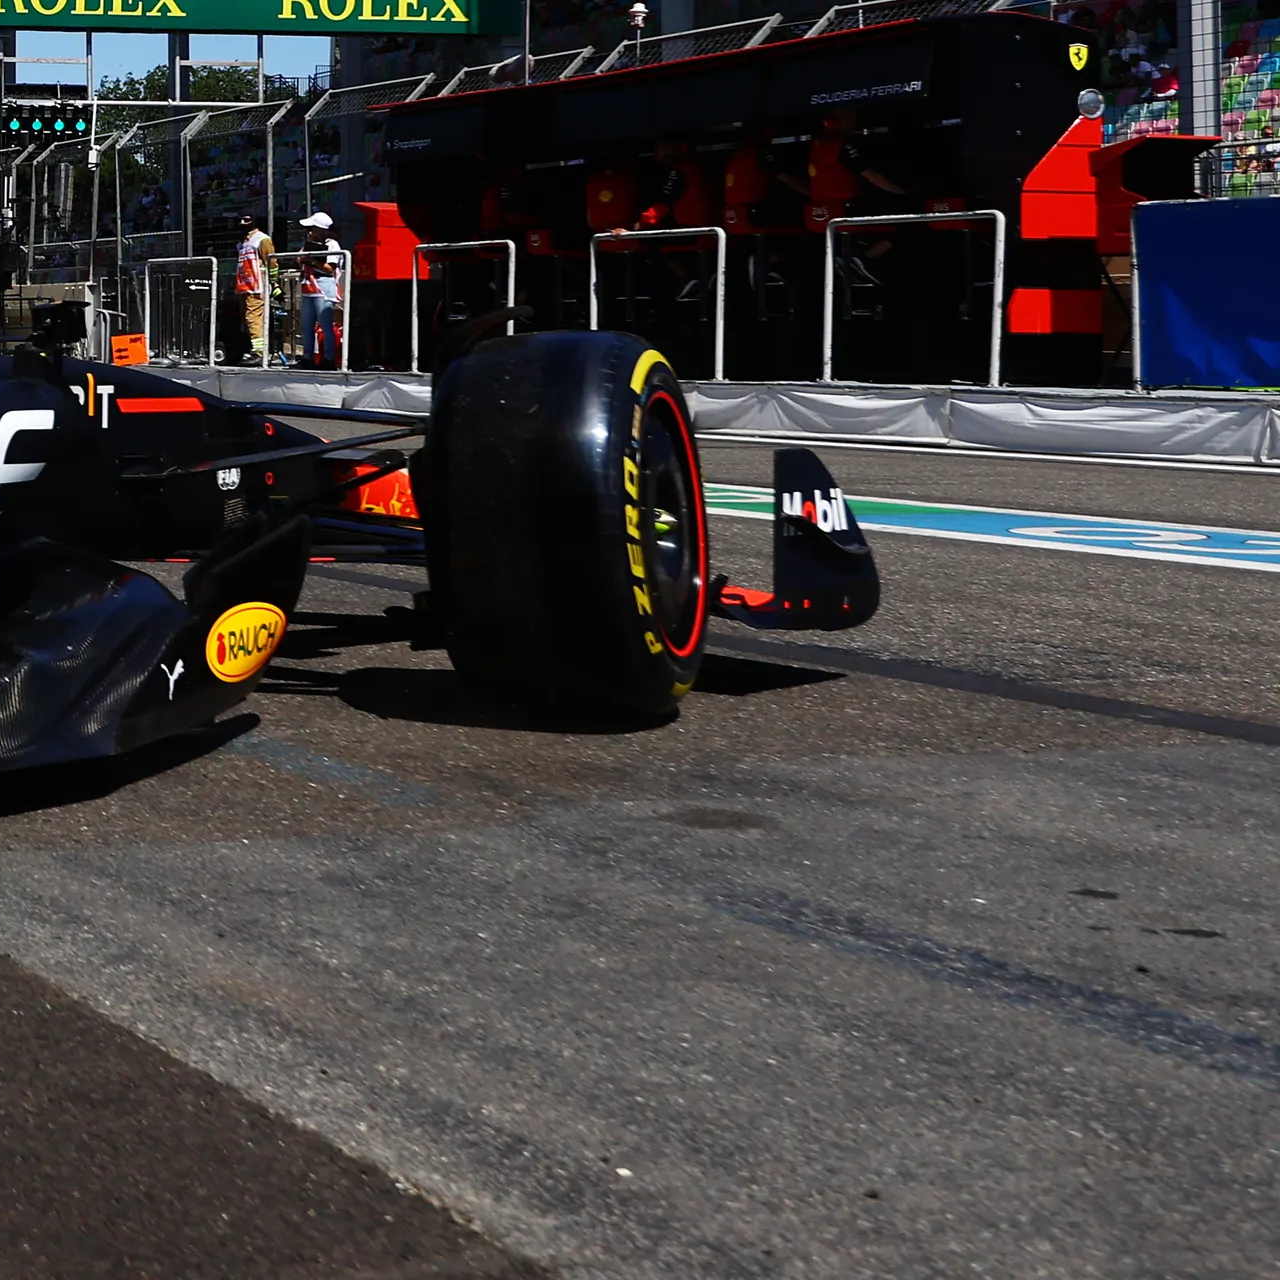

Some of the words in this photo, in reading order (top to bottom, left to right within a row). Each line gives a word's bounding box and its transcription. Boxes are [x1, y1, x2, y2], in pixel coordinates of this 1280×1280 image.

[809, 88, 868, 105] SCUDERIA
[870, 80, 922, 98] FERRARI
[392, 137, 432, 150] Snapdragon
[781, 487, 849, 533] Mobil
[623, 455, 654, 617] ZERO
[643, 630, 664, 656] P
[228, 618, 278, 661] RAUCH
